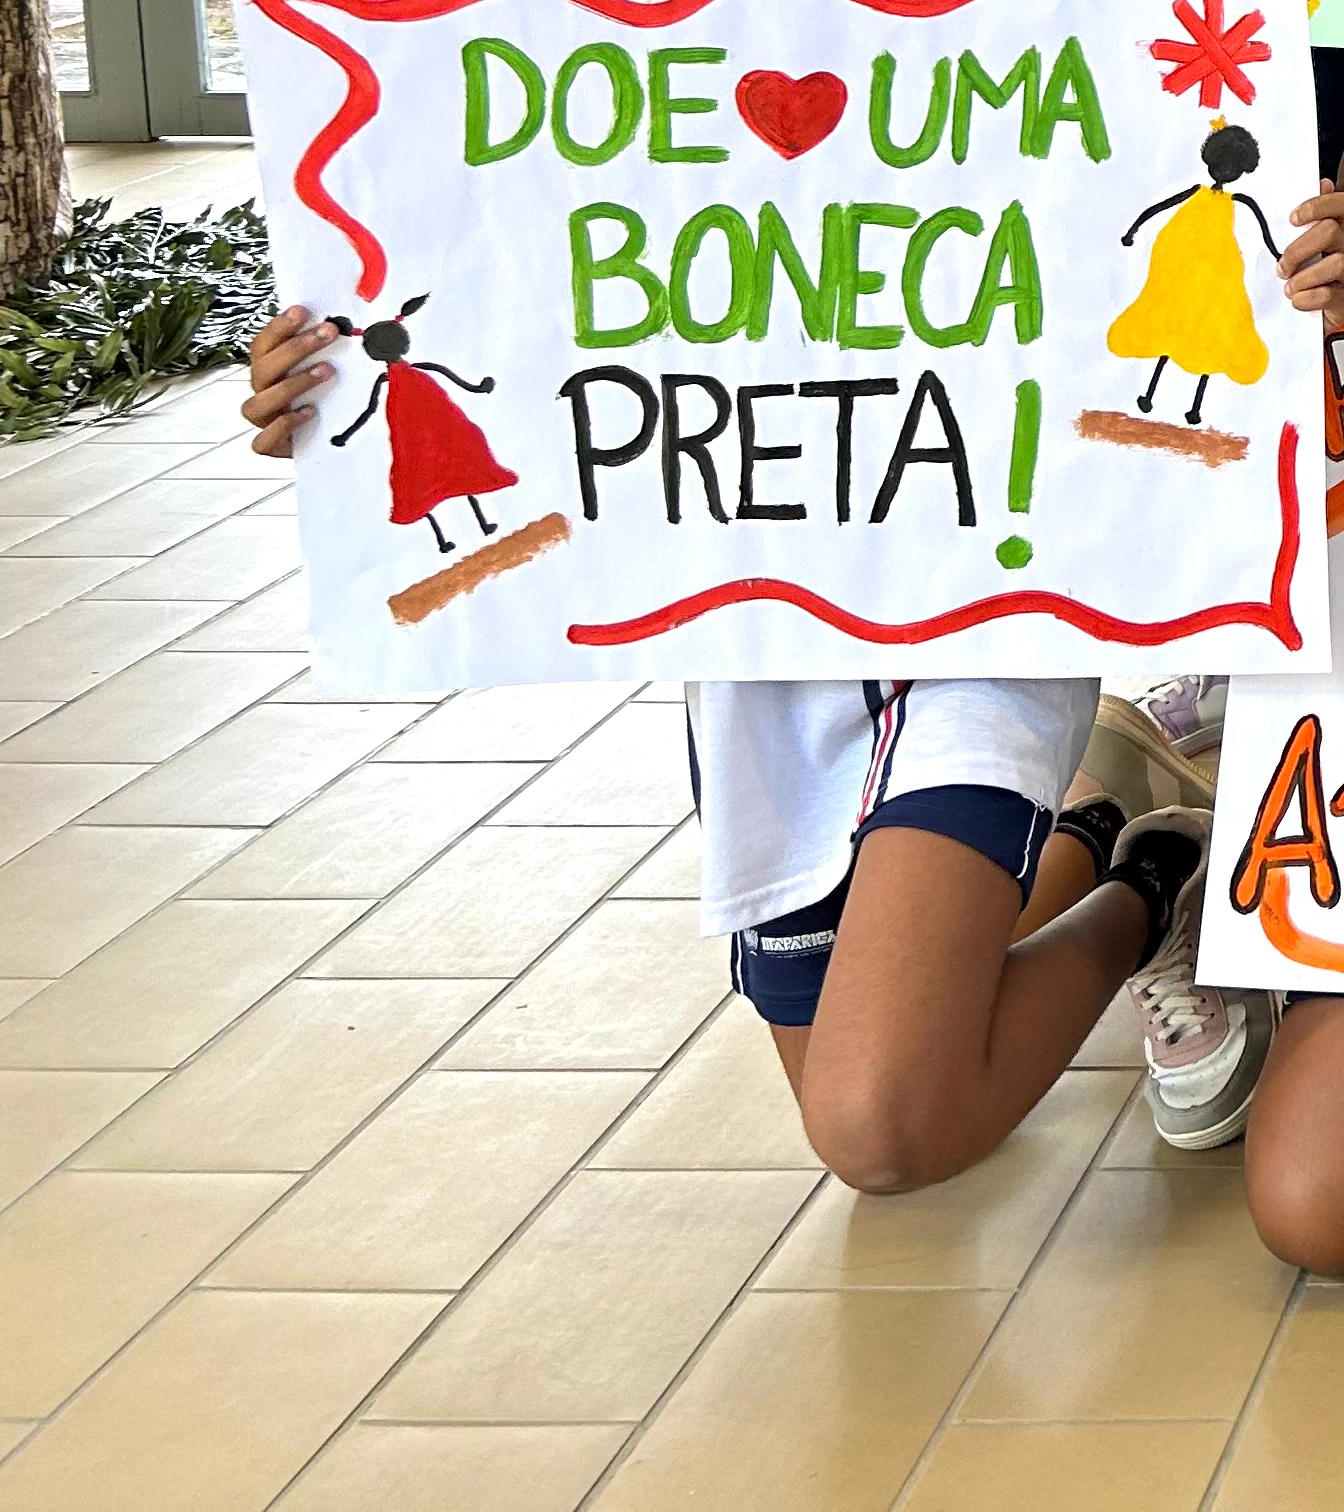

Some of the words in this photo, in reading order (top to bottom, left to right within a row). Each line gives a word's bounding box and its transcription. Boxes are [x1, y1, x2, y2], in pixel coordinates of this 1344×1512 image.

[462, 36, 730, 168] DOE
[868, 35, 1112, 169] UMA
[567, 199, 1043, 350] BONECA
